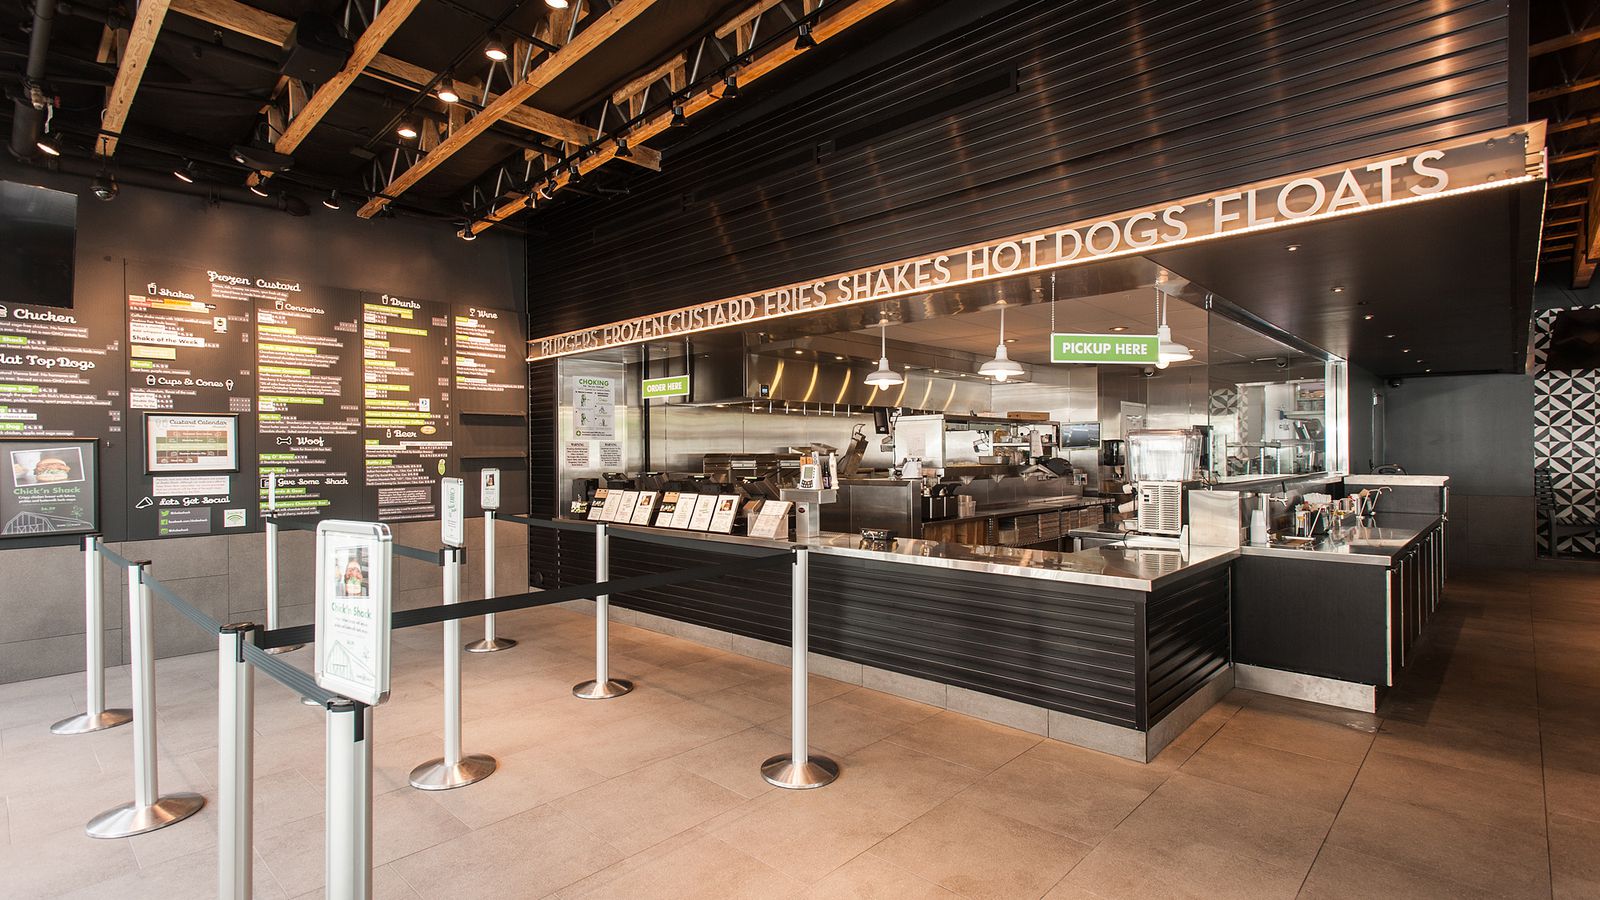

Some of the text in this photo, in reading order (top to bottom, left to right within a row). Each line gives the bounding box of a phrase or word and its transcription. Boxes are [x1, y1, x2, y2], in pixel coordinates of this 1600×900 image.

[604, 315, 665, 345] FROZEN
[668, 298, 756, 333] CUSTARD
[764, 282, 826, 316] FRIES
[837, 255, 951, 302] SHAKES
[966, 234, 1047, 280] HOT
[1055, 205, 1188, 263] DOGS
[1213, 150, 1450, 233] FLOATS
[207, 270, 301, 292] Frozen Custard
[158, 288, 195, 300] Shakes
[285, 303, 325, 314] Concretes
[390, 297, 421, 309] Drinks
[13, 308, 77, 324] Chicken
[477, 310, 498, 319] Wine
[132, 334, 155, 342] Shake
[1062, 342, 1147, 355] PICKUP HERE
[0, 353, 95, 371] lat Top Dogs
[158, 377, 224, 388] Cups & Cones
[579, 378, 609, 387] CHOKING
[647, 382, 682, 393] ORDER HERE
[393, 430, 417, 438] Beer
[296, 437, 325, 447] Woof
[277, 478, 296, 487] Give
[13, 486, 81, 495] Chick'n Shack
[182, 497, 200, 506] Get
[202, 496, 231, 504] Social
